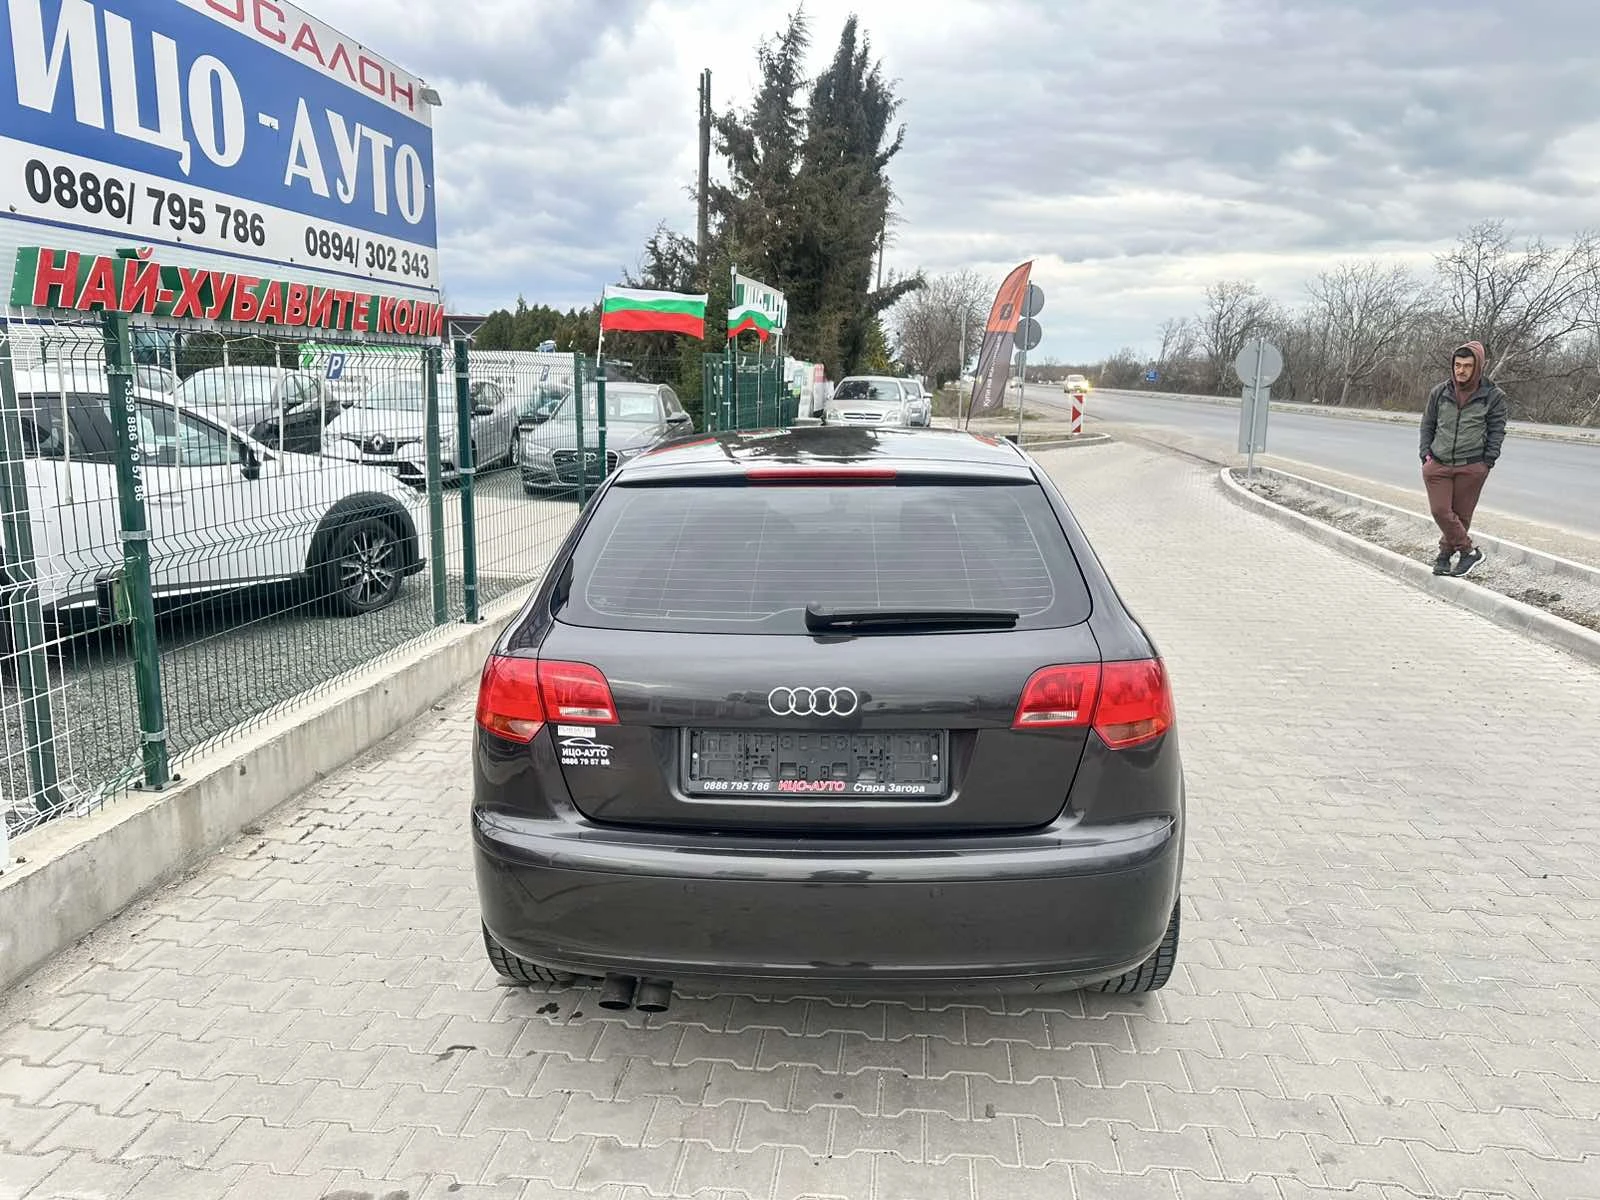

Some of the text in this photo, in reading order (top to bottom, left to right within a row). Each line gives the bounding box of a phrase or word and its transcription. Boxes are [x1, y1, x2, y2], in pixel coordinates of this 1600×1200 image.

[25, 158, 266, 247] 0886/ 795 786
[305, 226, 429, 279] 0894/ 302 343
[32, 245, 444, 337] НАЙ-ХУБАВИТЕ КОЛИ
[328, 355, 342, 377] P
[124, 379, 145, 501] +359 886 79 57 86
[562, 748, 608, 757] ИЦО-АУТО
[703, 779, 926, 793] 0886 795 786 ИЦО-АУТО Стара Загора
